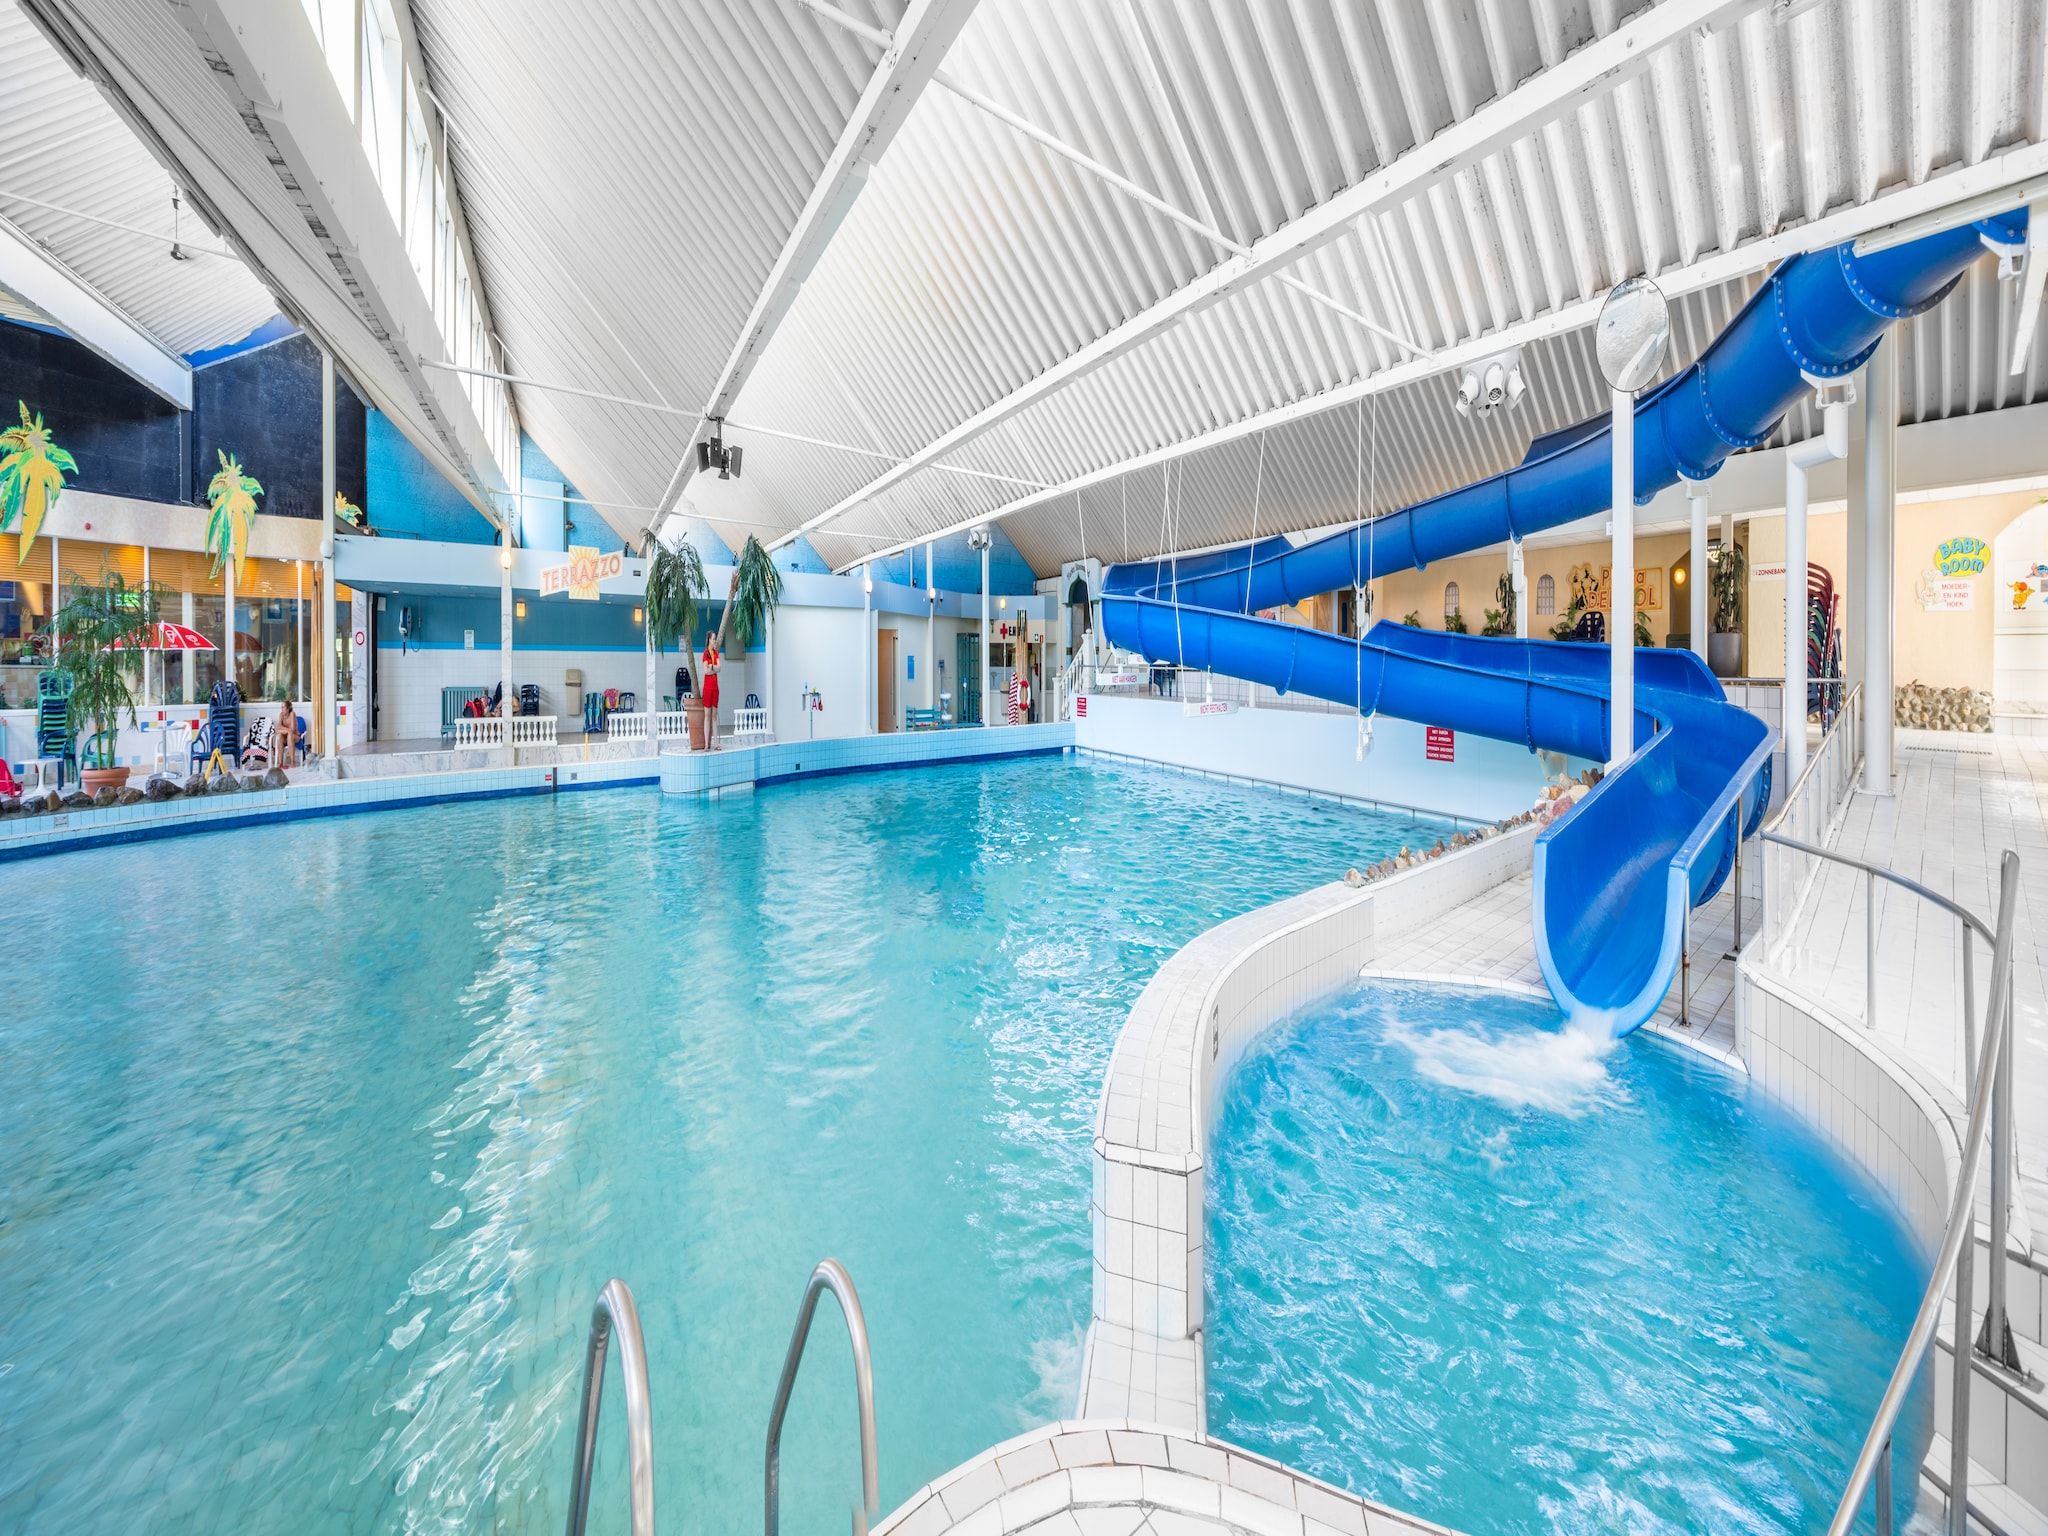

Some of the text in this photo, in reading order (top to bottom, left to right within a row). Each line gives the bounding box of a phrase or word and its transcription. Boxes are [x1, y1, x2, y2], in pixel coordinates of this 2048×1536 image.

[1939, 537, 1985, 560] BABY
[543, 555, 620, 592] TERRAZZO
[1941, 557, 1985, 576] ROOM
